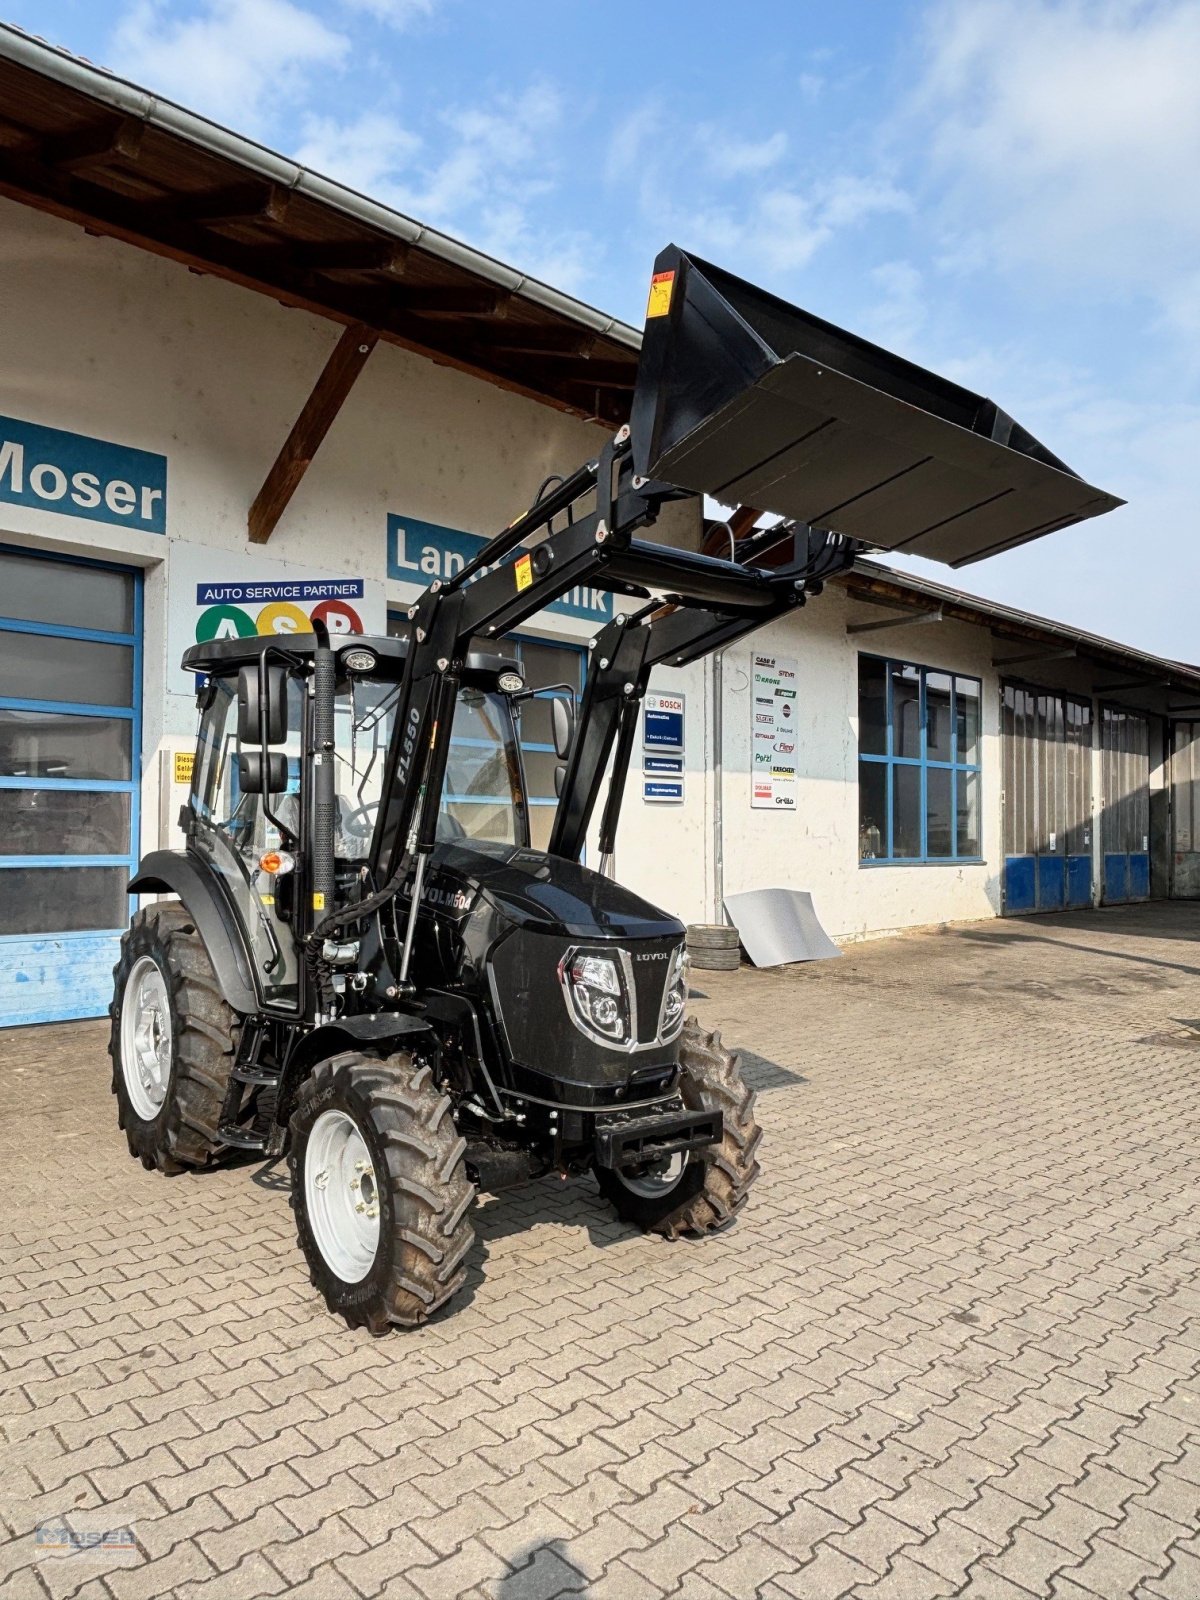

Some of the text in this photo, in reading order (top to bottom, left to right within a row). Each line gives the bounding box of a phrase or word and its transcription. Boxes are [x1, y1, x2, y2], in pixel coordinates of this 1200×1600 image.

[0, 441, 162, 520] Moser
[204, 584, 358, 600] AUTO SERVICE PARTNER
[778, 670, 795, 678] STEYR
[761, 677, 780, 685] KRONE
[659, 699, 682, 710] BOSCH
[397, 707, 420, 785] FL550
[636, 952, 669, 962] LOVOL
